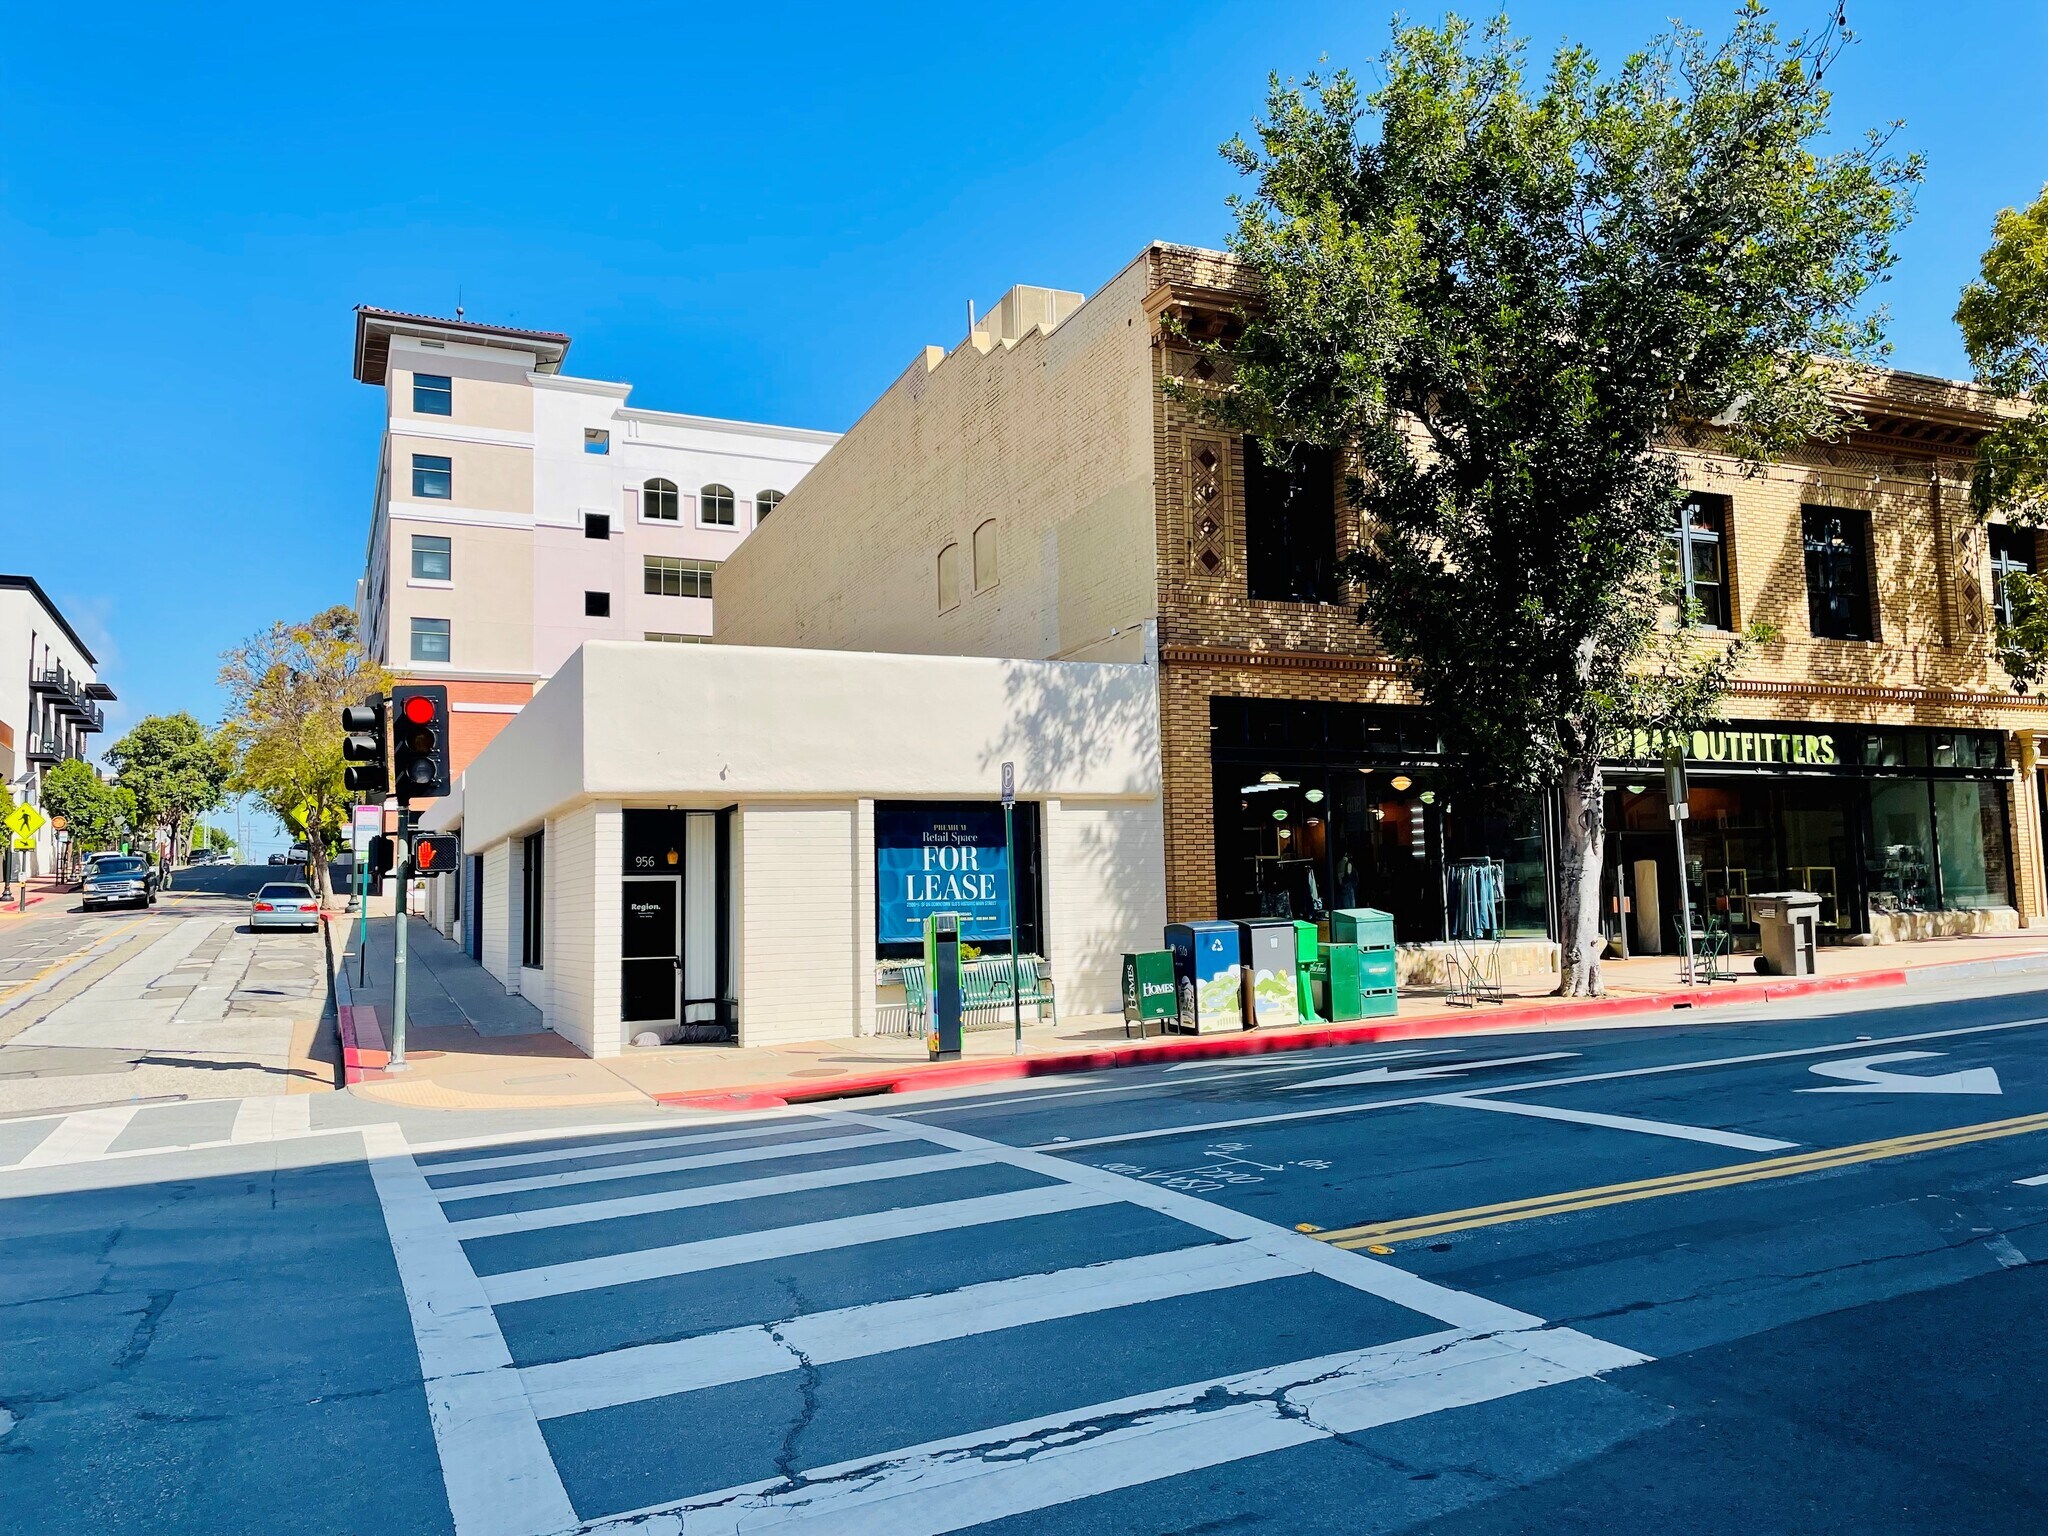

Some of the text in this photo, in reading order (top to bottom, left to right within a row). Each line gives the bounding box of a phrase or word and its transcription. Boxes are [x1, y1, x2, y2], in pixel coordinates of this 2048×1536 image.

[1692, 730, 1835, 764] OUTFITTERS
[922, 832, 978, 845] Retail Space
[635, 856, 655, 867] 956
[922, 845, 980, 871] FOR
[906, 874, 996, 901] LEASE
[631, 903, 661, 911] Region.
[1127, 964, 1137, 1009] HOMES
[1142, 982, 1175, 998] HOMES
